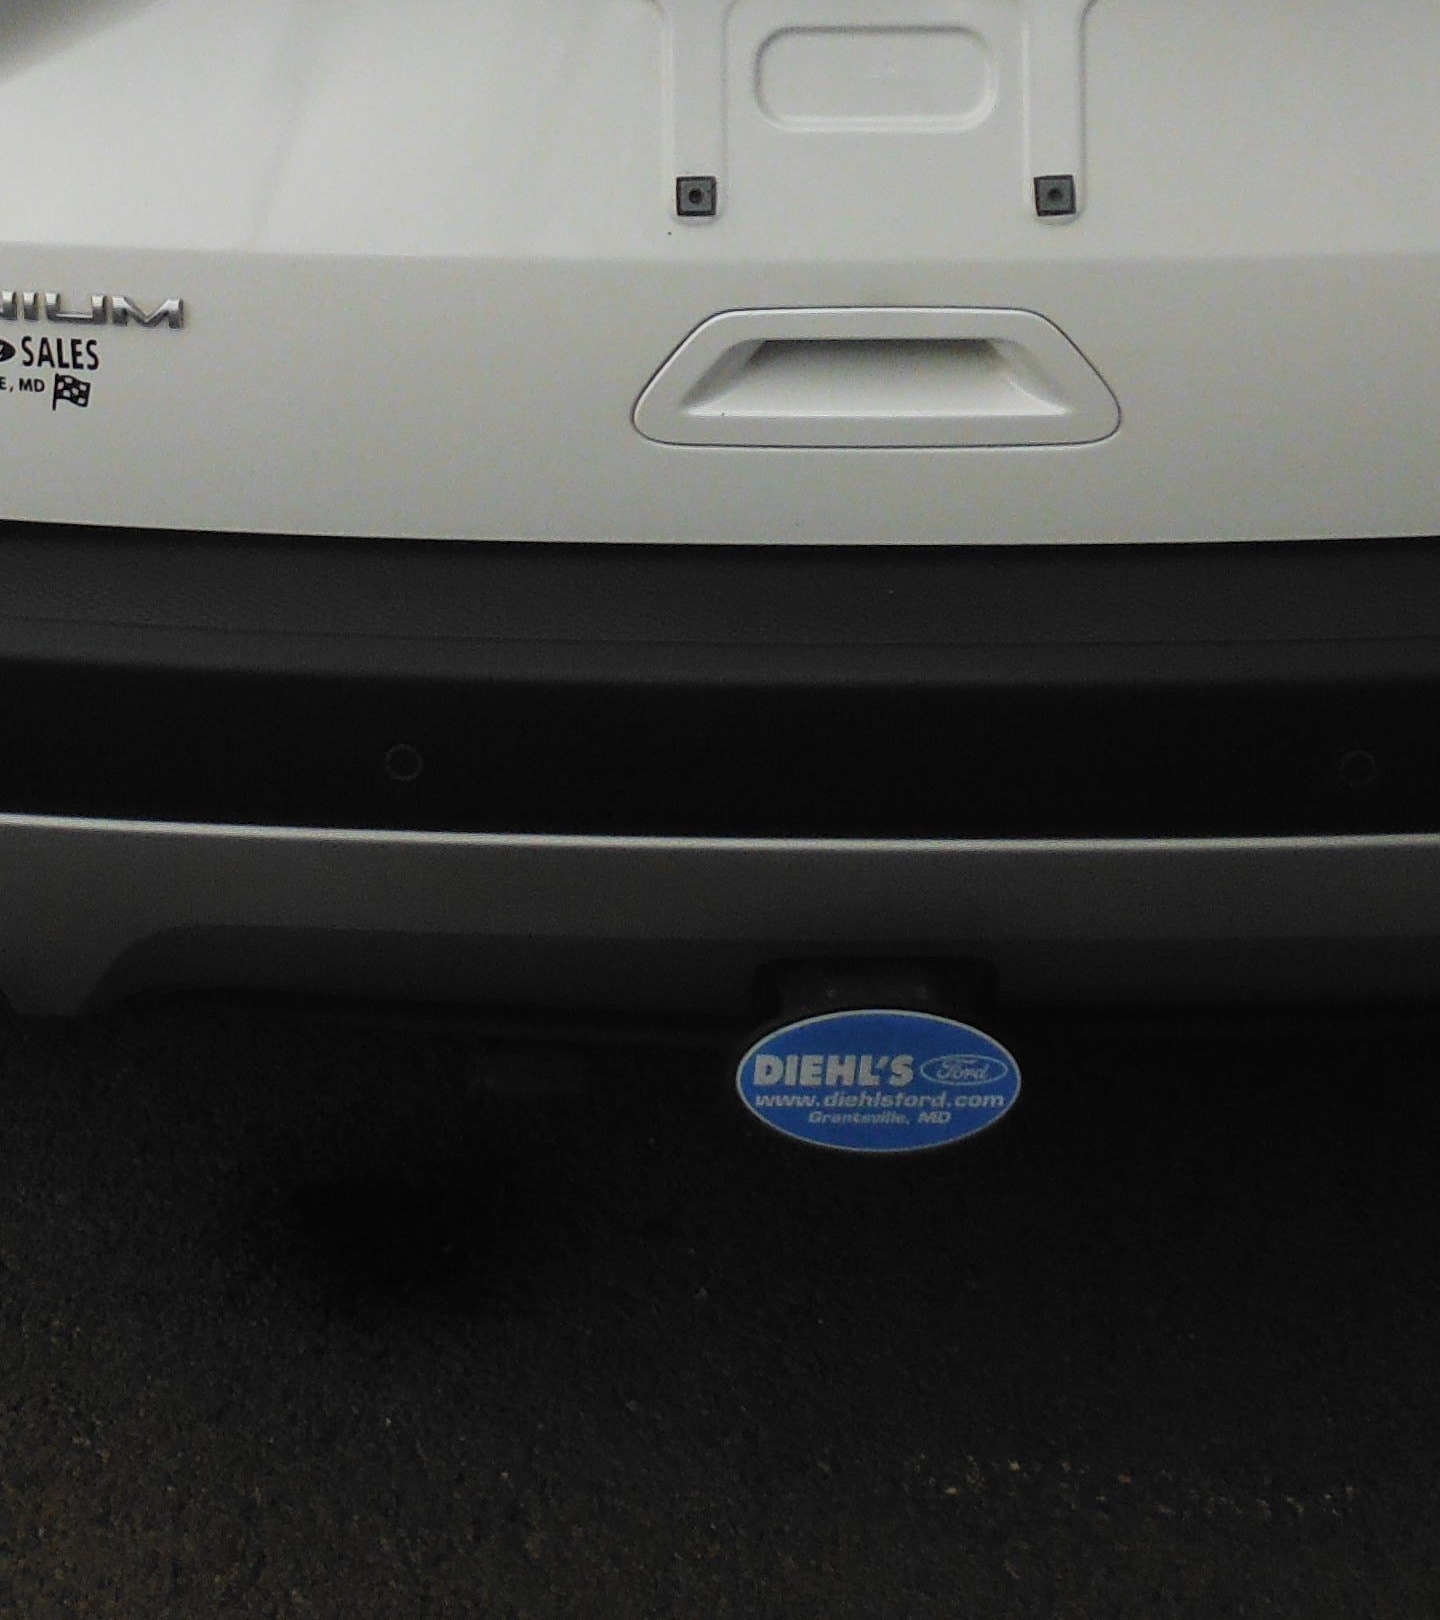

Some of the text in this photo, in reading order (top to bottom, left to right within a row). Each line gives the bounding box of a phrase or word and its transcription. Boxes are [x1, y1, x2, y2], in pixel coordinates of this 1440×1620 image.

[21, 336, 100, 370] SALES
[19, 378, 45, 393] MD
[753, 1054, 990, 1086] DIEHL'S Ford
[755, 1091, 1006, 1108] www.diehlsford.com
[918, 1111, 951, 1124] MD
